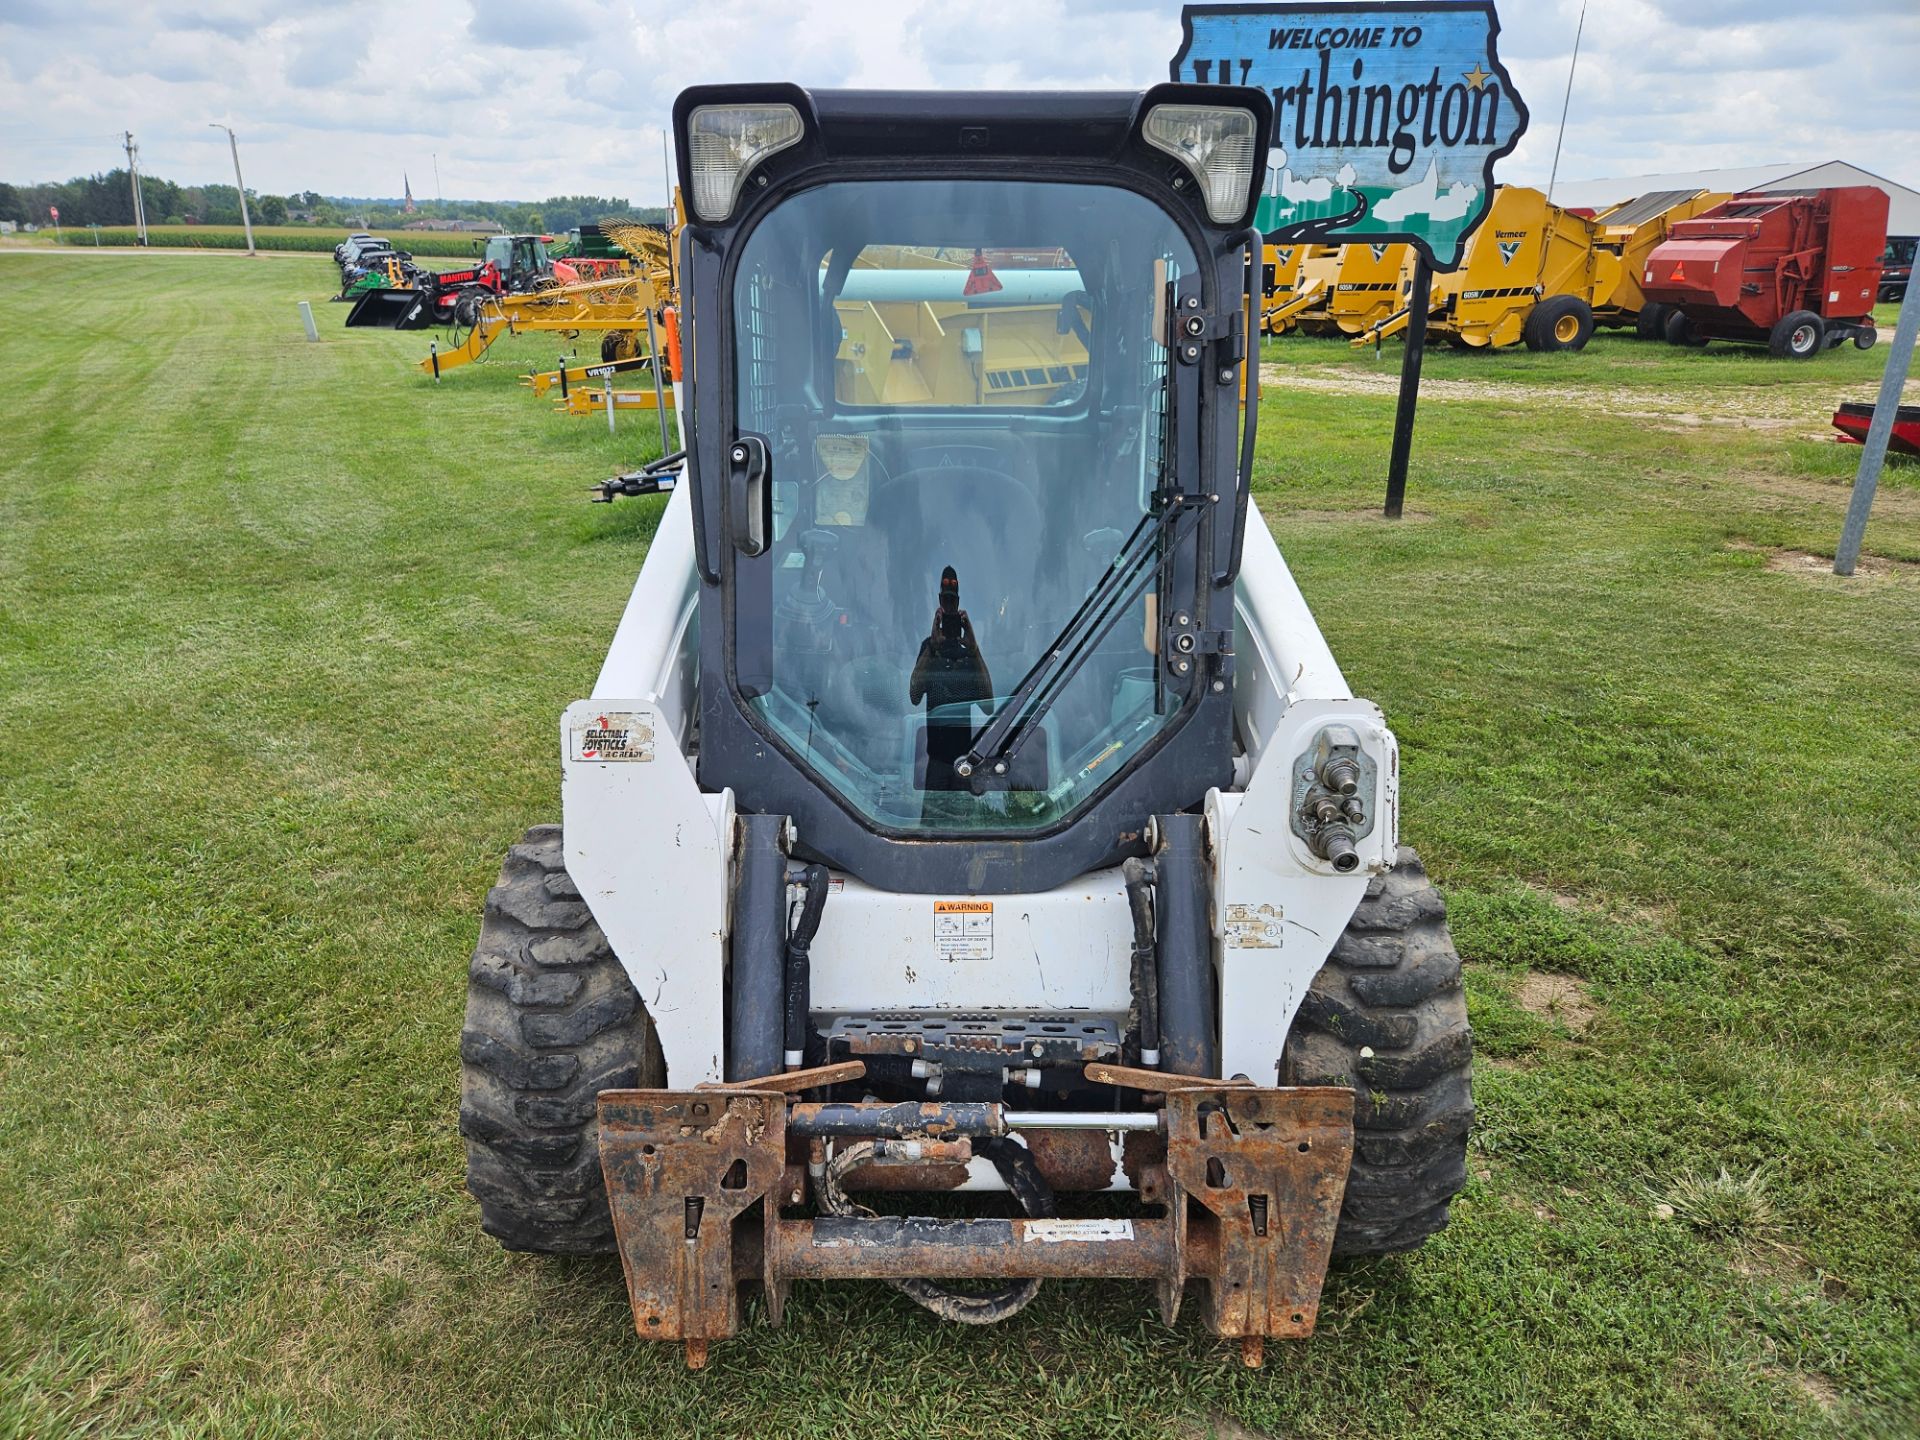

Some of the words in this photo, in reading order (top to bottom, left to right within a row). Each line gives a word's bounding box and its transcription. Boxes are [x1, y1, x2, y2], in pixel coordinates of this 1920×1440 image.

[1268, 28, 1385, 50] WELCOME
[1390, 26, 1423, 47] TO
[1193, 48, 1501, 174] rthington
[1495, 230, 1527, 239] Vermeer
[440, 271, 474, 284] MANITOU
[585, 729, 629, 738] SELECTABLE
[582, 739, 627, 750] JOYSTICKS
[947, 903, 989, 911] WARNING
